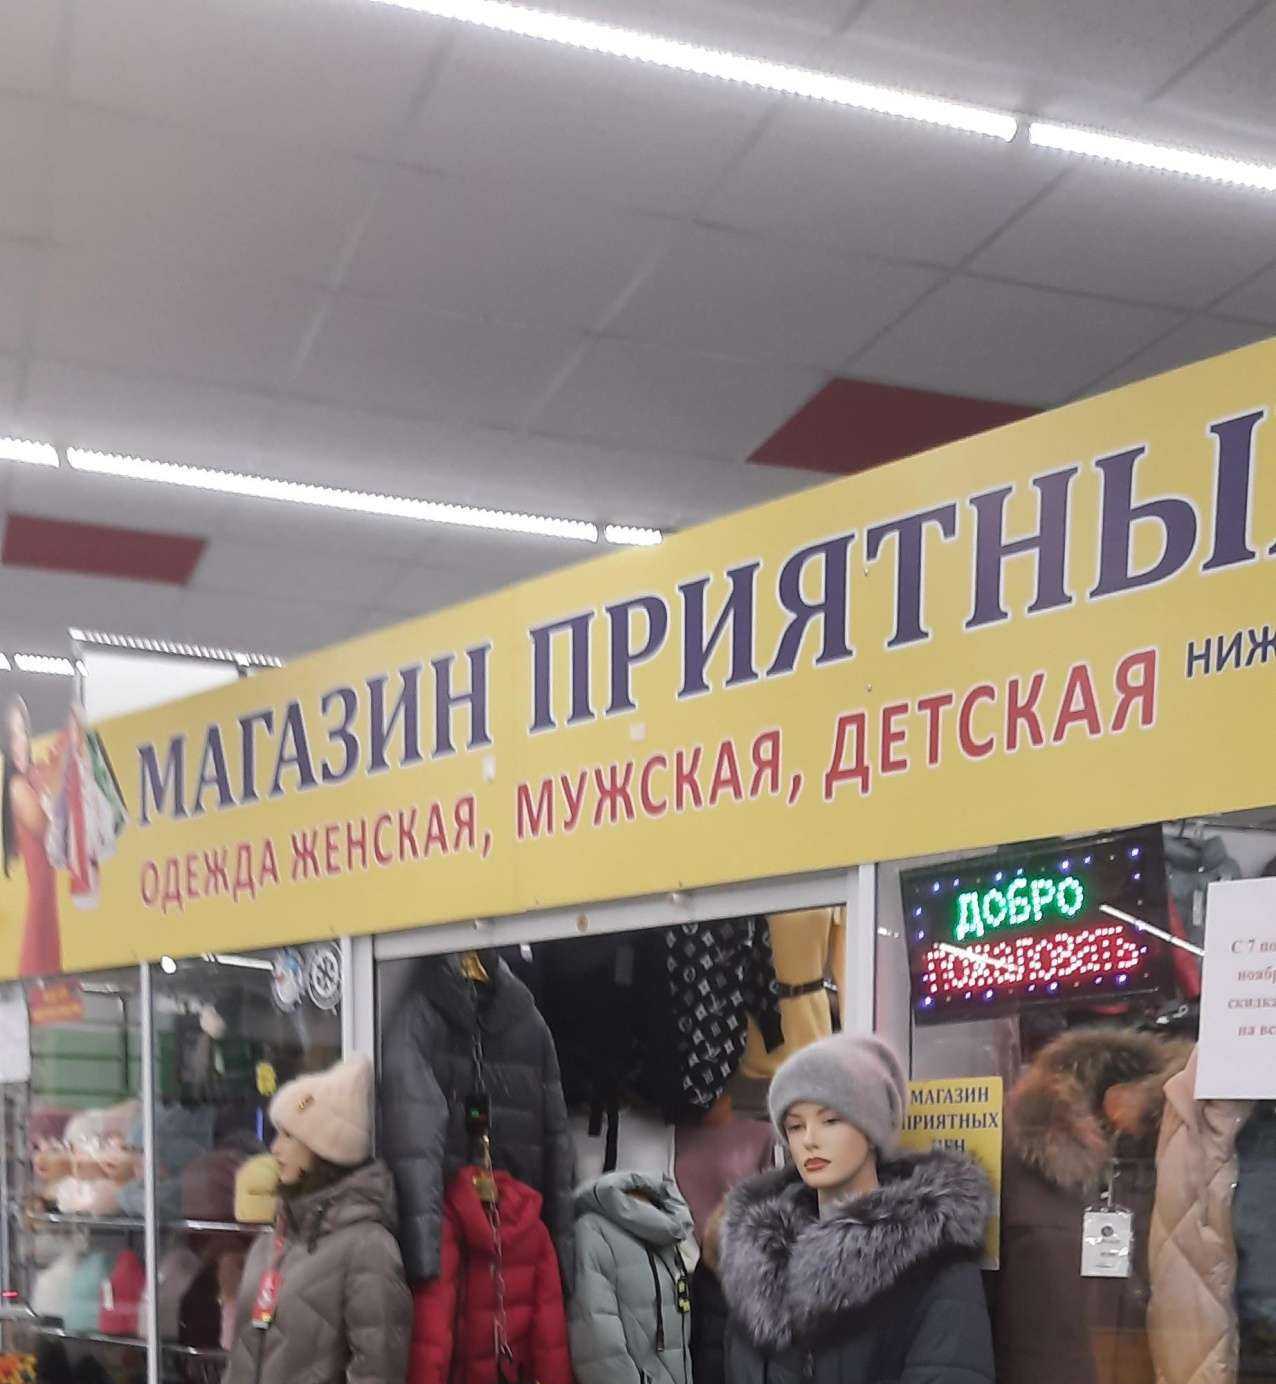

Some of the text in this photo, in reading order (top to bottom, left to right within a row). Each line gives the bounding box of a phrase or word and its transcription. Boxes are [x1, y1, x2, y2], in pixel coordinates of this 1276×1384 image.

[136, 410, 1276, 826] МАГАЗИН ПРИЯТНЫ
[1185, 625, 1276, 679] НИЖ
[140, 649, 1157, 913] ОДЕЖДА ЖЕНСКАЯ, МУЖСКАЯ, ДЕТСКАЯ
[955, 876, 1085, 941] ДОБРО
[926, 925, 1140, 993] ПОЖАЛОВАТЬ
[910, 1086, 989, 1105] МАГАЗИН
